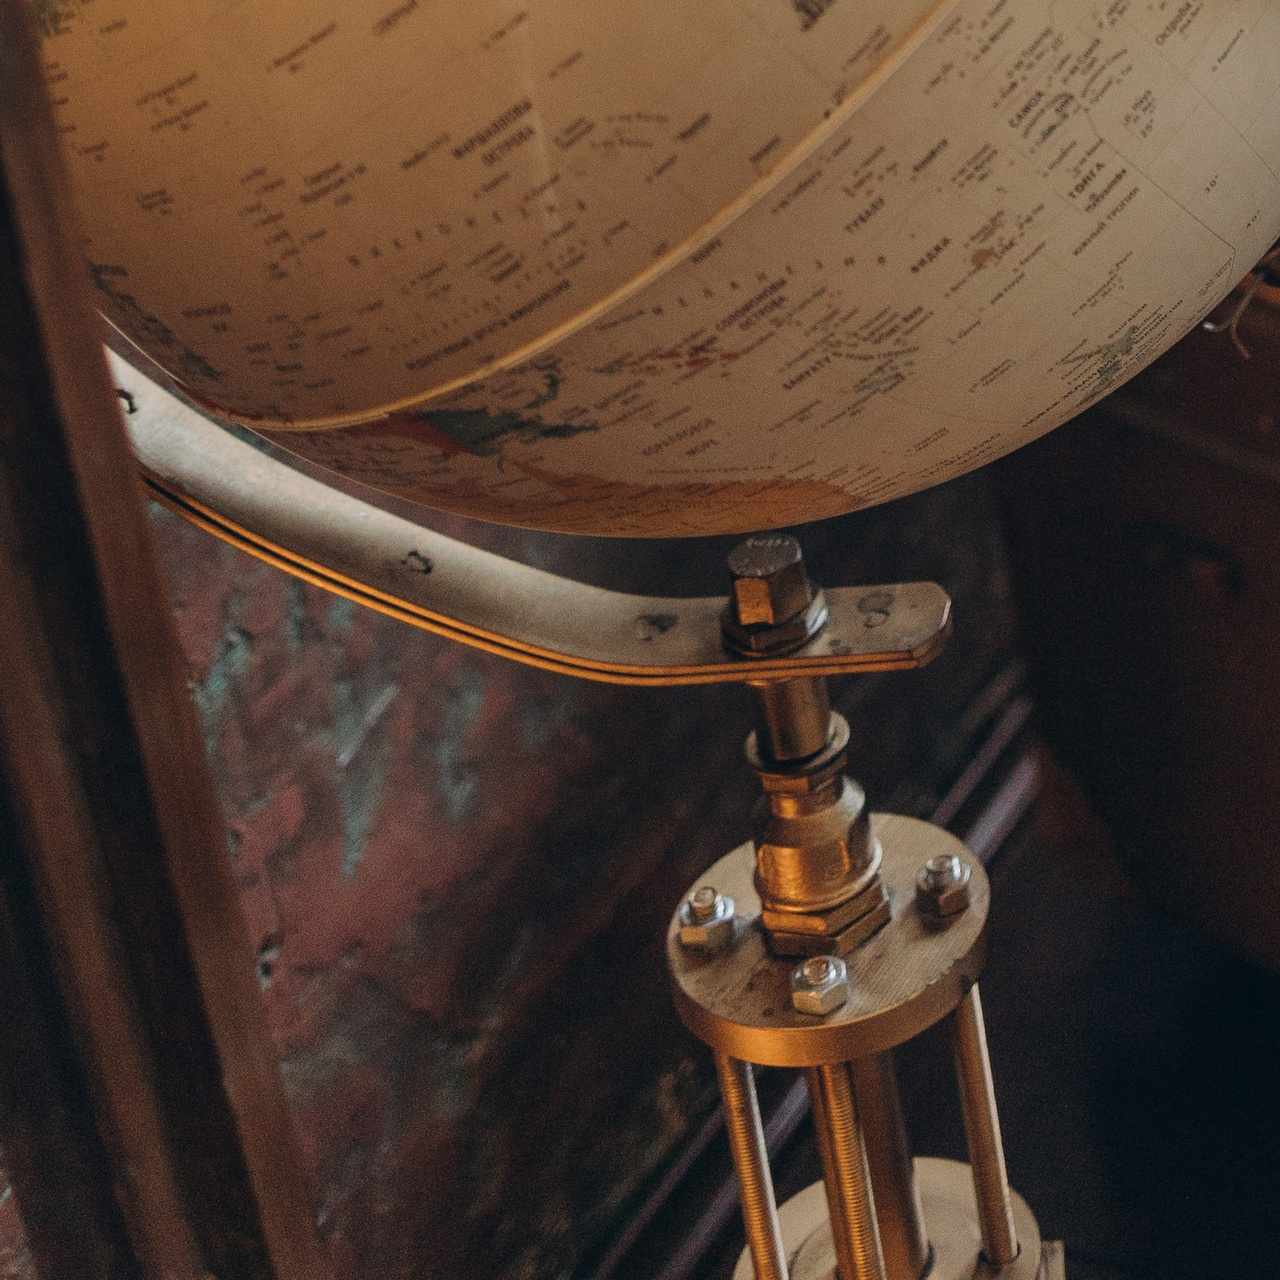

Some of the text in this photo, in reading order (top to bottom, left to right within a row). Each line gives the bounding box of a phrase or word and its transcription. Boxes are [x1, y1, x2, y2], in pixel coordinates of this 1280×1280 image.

[1152, 0, 1195, 48] Острова
[1006, 86, 1046, 131] САМОА
[1066, 158, 1107, 203] ТОНГА
[1083, 164, 1129, 216] Нукуалофа
[843, 191, 887, 237] ТУВАЛУ
[1069, 184, 1141, 259] ЮЖНЫЙ ТРОПИК
[908, 231, 953, 278] ФИДЖИ
